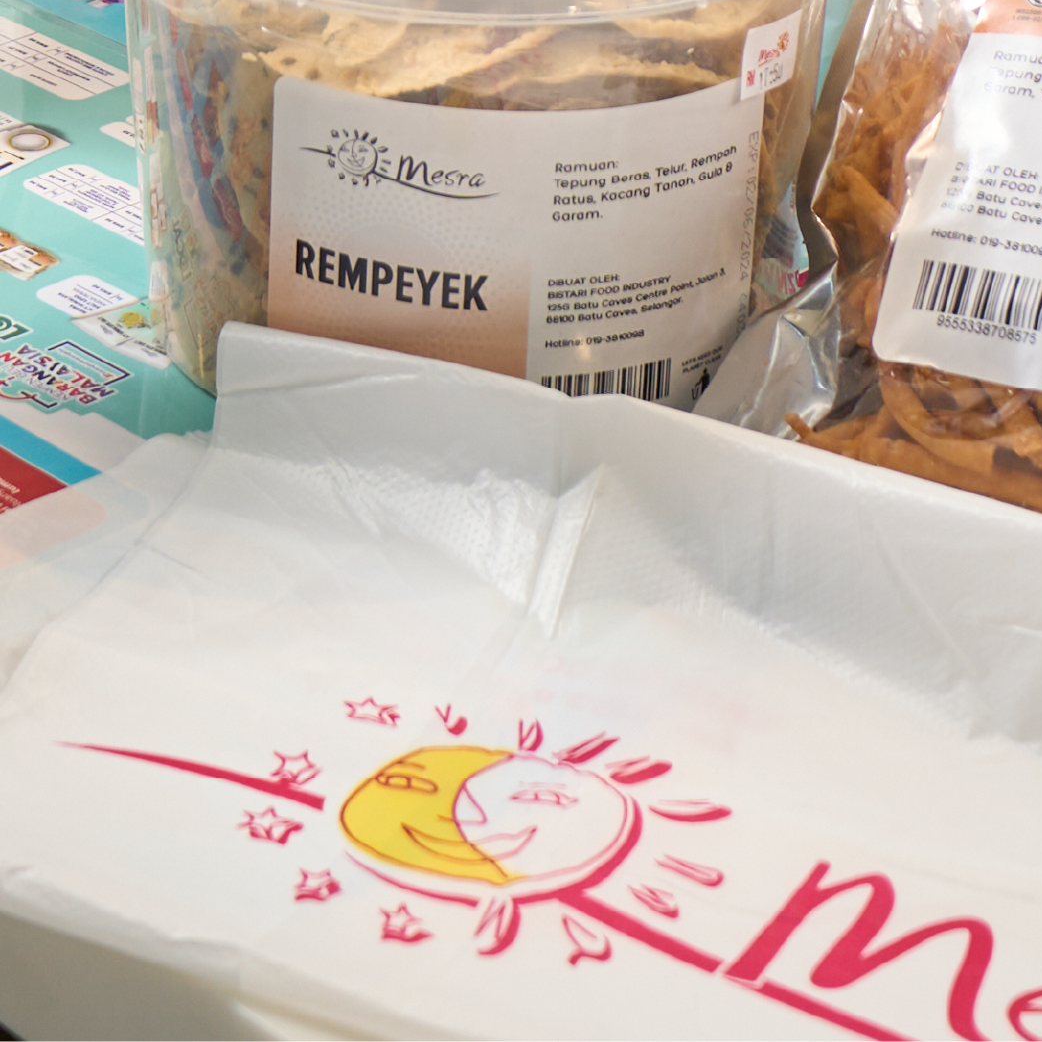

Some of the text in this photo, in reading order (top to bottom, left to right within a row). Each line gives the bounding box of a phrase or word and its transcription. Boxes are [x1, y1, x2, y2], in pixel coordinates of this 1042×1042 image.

[396, 154, 486, 188] Mesra
[554, 177, 606, 189] Tepung
[691, 145, 737, 169] Rempah
[555, 160, 619, 174] Ramuan:
[601, 186, 651, 202] Kacang
[698, 167, 723, 181] Gula
[1000, 179, 1036, 194] FOOD
[976, 190, 1007, 205] Batu
[552, 209, 604, 222] Garam.
[977, 205, 1008, 218] Batu
[931, 228, 978, 244] Hotline:
[295, 238, 489, 312] REMPEYEK
[547, 276, 587, 287] DIBUAT
[547, 275, 672, 300] BISTARI FOOD INDUSTRY
[574, 299, 599, 311] Batu
[602, 296, 633, 309] Caves
[636, 288, 668, 303] Centre
[546, 314, 575, 325] 68100
[578, 311, 603, 323] Batu
[936, 314, 1037, 345] 9555338708575
